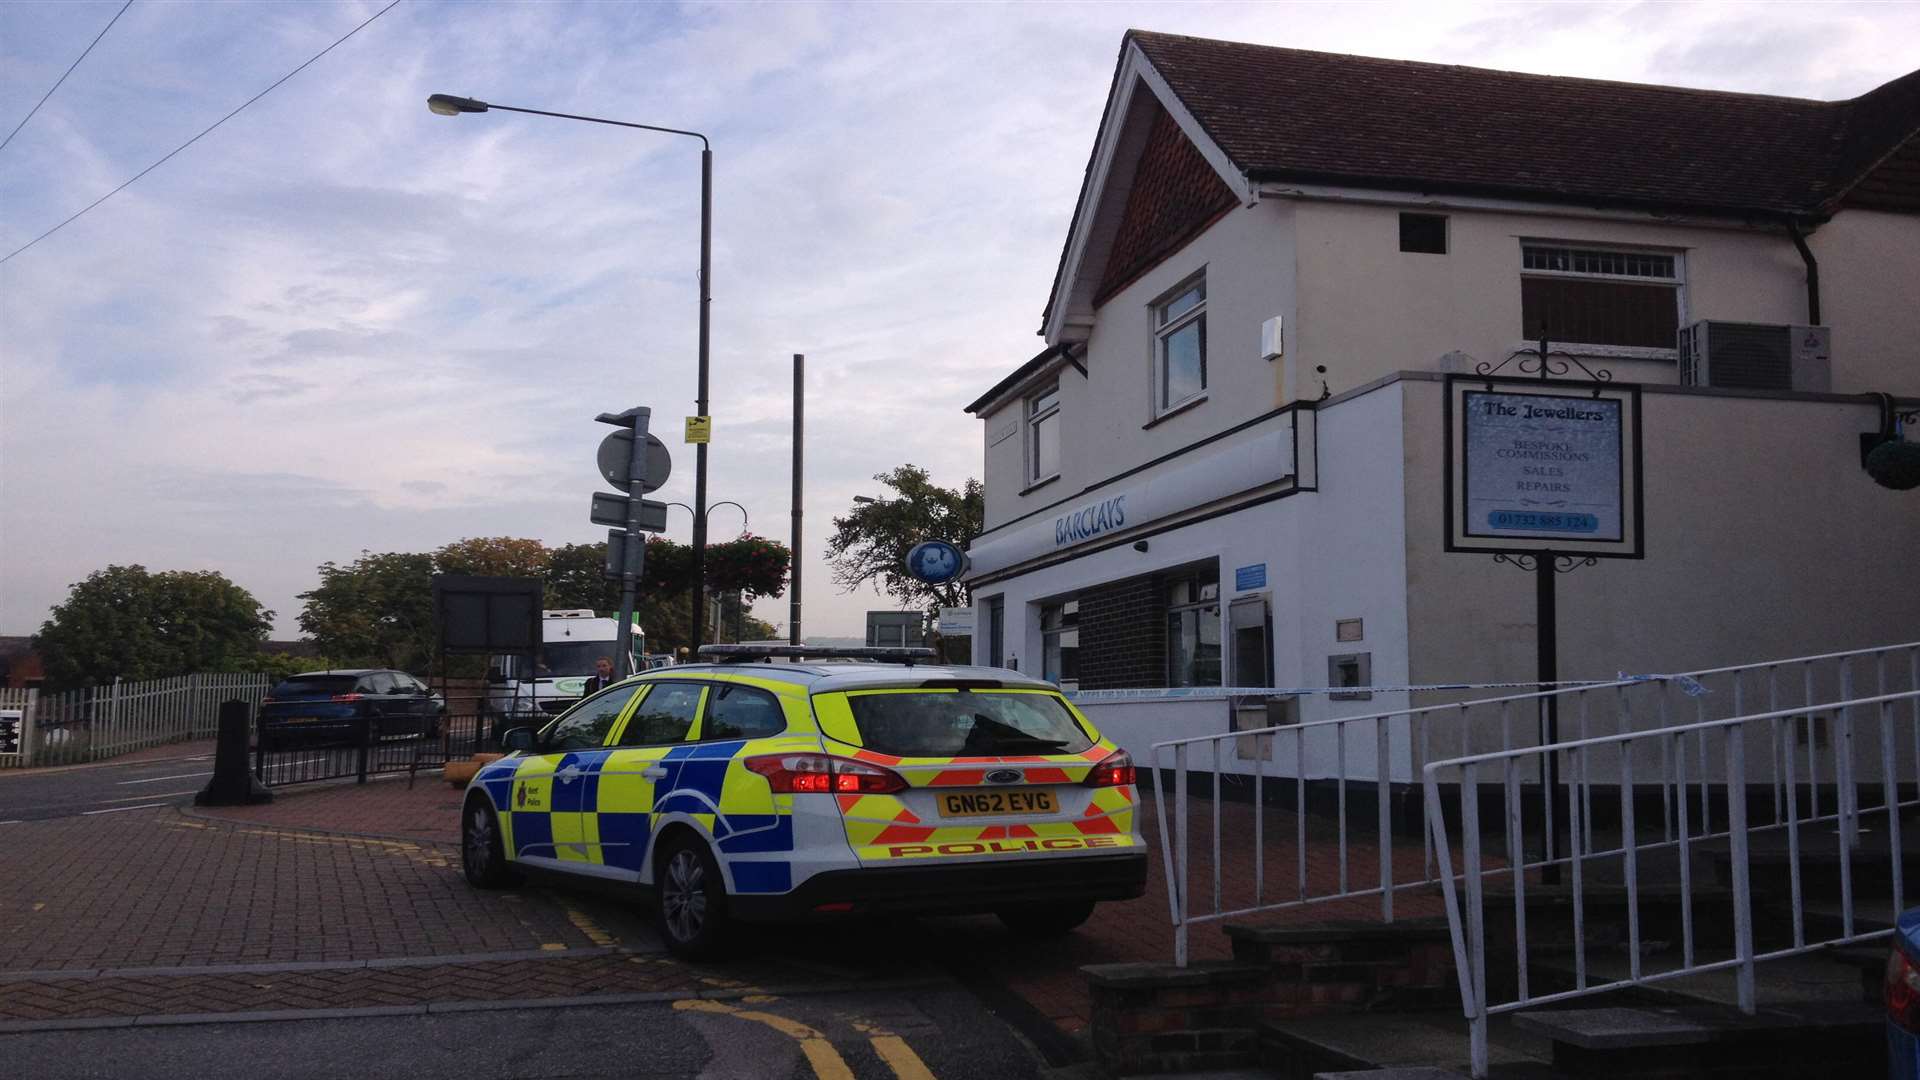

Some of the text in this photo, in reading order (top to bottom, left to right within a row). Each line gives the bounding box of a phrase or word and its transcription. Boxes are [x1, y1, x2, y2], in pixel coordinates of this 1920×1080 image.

[1484, 402, 1604, 421] The Jewellers
[1513, 440, 1570, 451] BESPOKE
[1496, 449, 1589, 461] COMMISSIONS
[1523, 466, 1564, 477] SALES
[1517, 481, 1571, 492] REPAIRS
[1055, 495, 1125, 546] BARCLAYS
[1498, 513, 1536, 525] 01732
[946, 793, 1050, 813] GN62 EVG
[888, 837, 1118, 858] POLICE
